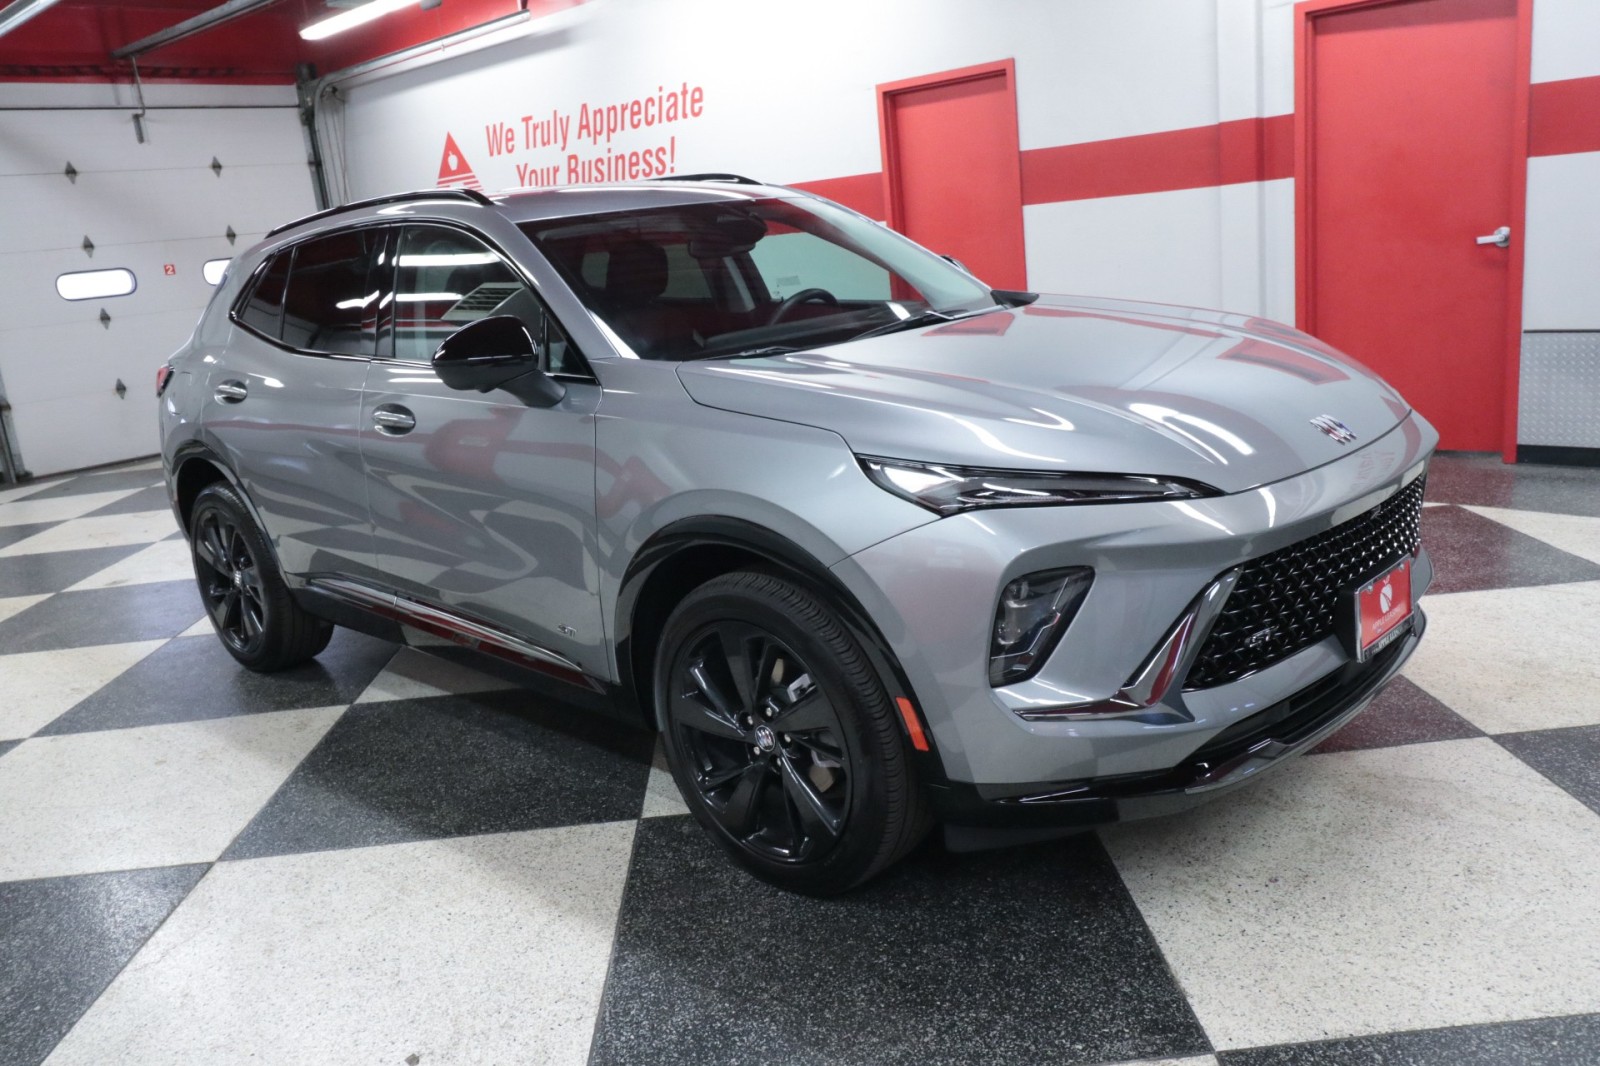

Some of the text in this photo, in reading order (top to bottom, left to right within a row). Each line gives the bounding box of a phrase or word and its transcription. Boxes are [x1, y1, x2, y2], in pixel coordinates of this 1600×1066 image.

[486, 82, 704, 157] We Truly Appreciate
[516, 135, 676, 188] Your Business!
[165, 265, 175, 275] 2
